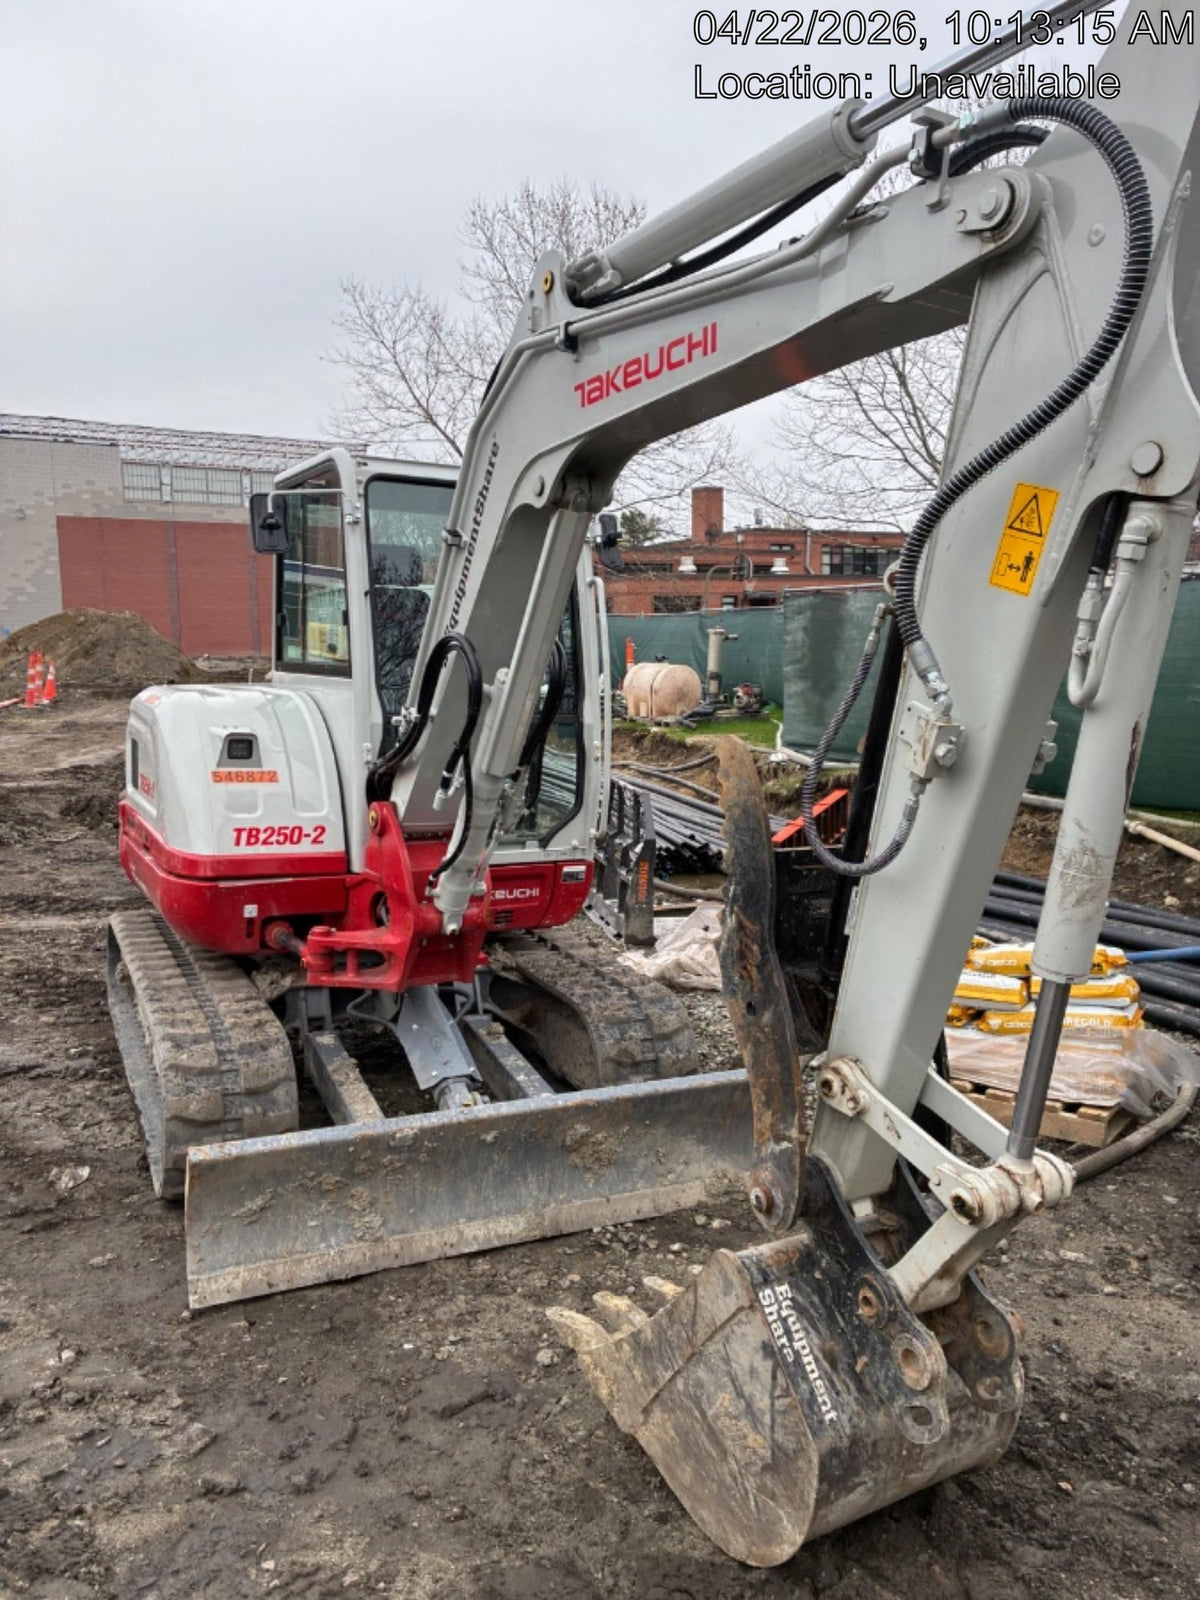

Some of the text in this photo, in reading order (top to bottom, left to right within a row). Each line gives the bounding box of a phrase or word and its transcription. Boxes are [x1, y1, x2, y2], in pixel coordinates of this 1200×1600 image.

[211, 770, 279, 783] 546872
[233, 825, 326, 847] TB250-2
[774, 1282, 838, 1425] Equipment
